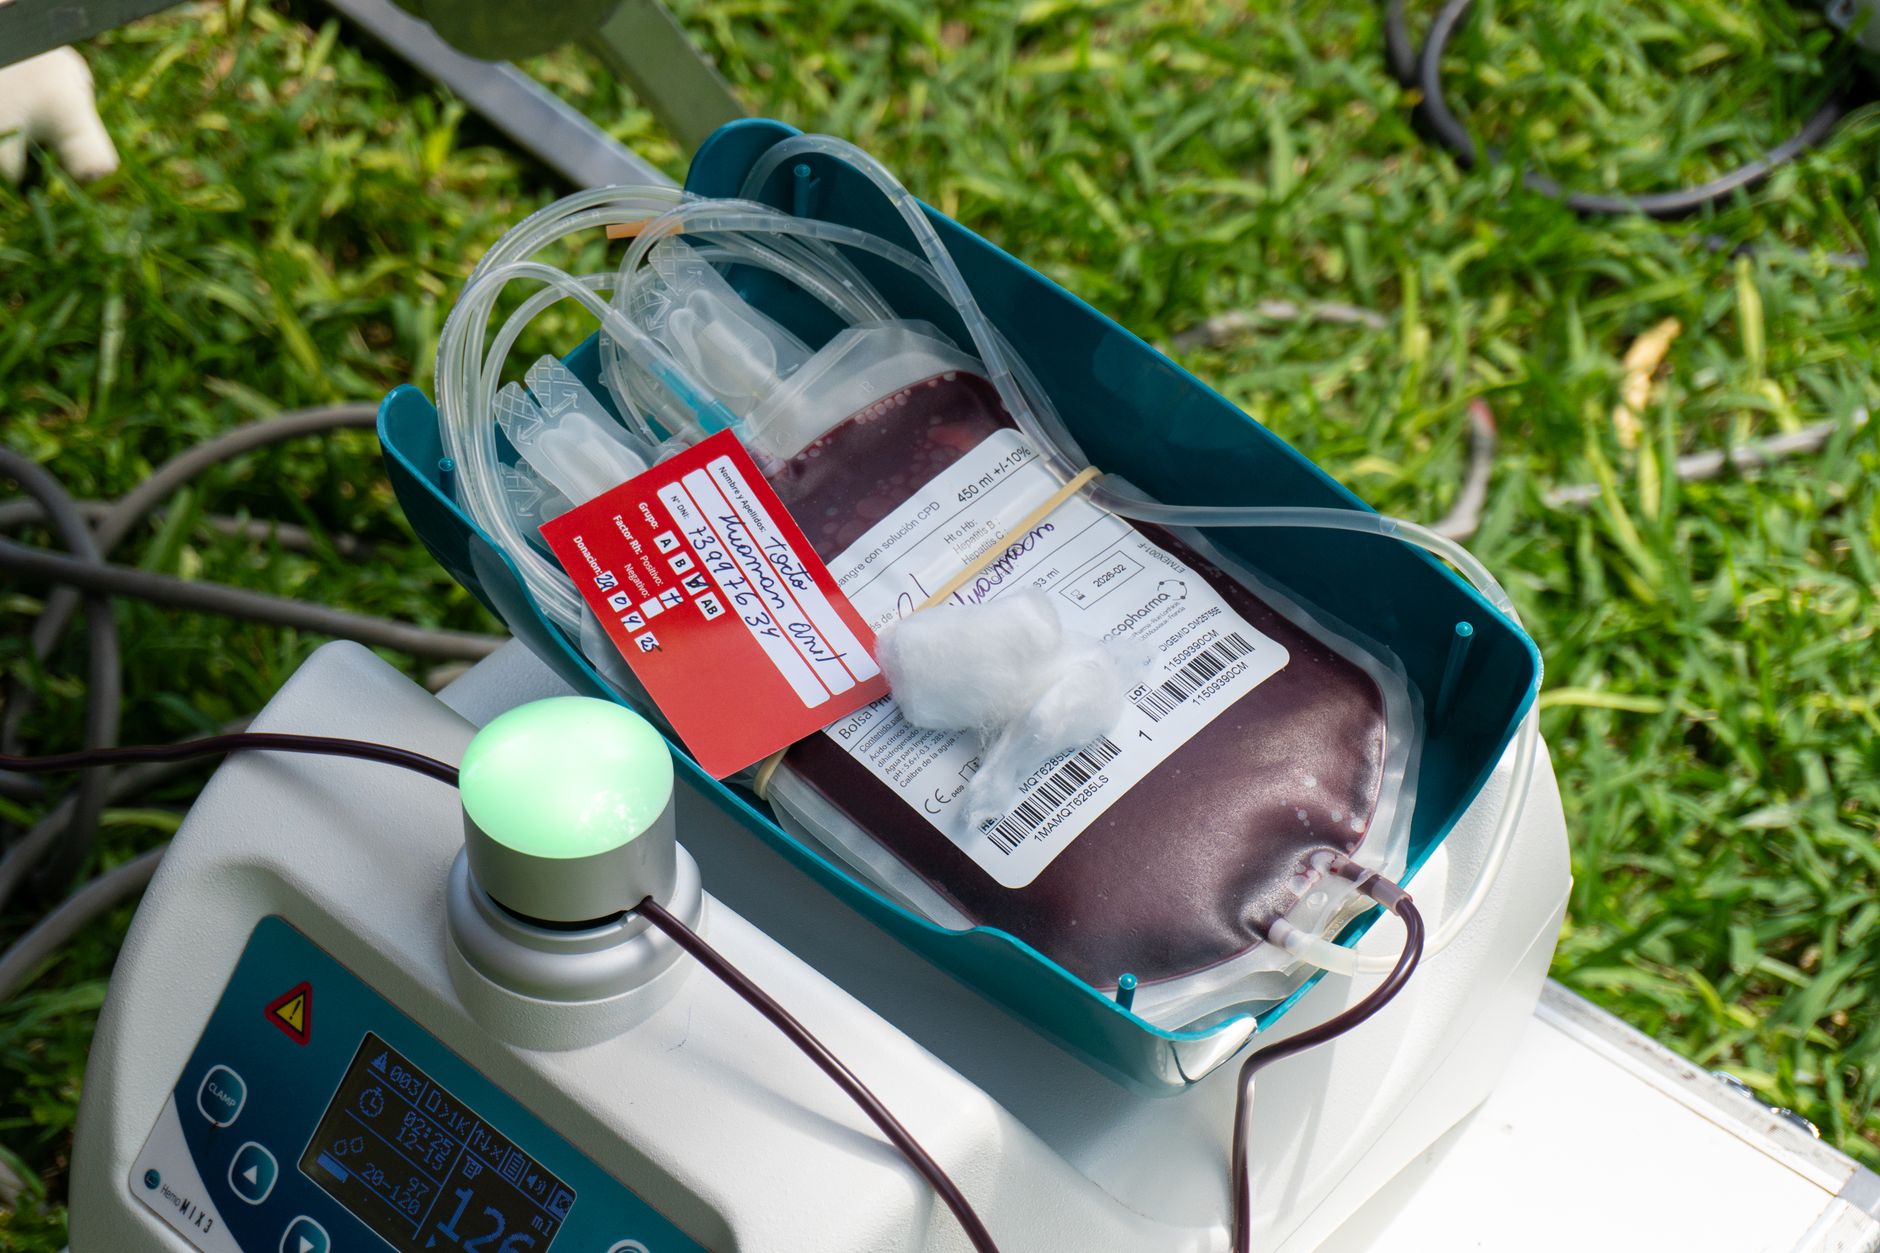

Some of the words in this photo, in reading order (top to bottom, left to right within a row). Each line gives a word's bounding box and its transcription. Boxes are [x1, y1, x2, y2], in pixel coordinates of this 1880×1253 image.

[955, 482, 980, 505] 450
[976, 472, 994, 489] ml
[990, 443, 1031, 478] +/-10%
[675, 503, 690, 521] DNI:
[718, 465, 740, 495] Nombre
[739, 498, 766, 533] Apellidos:
[835, 562, 866, 589] angre
[862, 545, 884, 564] con
[880, 516, 918, 550] solución
[915, 499, 941, 522] CPD
[943, 531, 957, 545] Ht
[960, 516, 978, 533] Hb:
[952, 525, 989, 555] Hepatitis
[572, 534, 603, 576] Donacion:
[612, 514, 633, 541] Factor
[629, 538, 643, 556] Rh:
[639, 554, 664, 587] Positivo:
[638, 501, 659, 529] Grupo:
[660, 539, 671, 548] A
[674, 558, 686, 568] B
[700, 597, 718, 616] AB
[961, 535, 996, 565] Hepatitis
[1137, 541, 1185, 574] ETMEX001-F
[623, 562, 651, 599] Negativo:
[1045, 565, 1060, 580] ml
[1091, 563, 1127, 587] 2026-02
[878, 610, 894, 625] de
[1158, 626, 1191, 652] DIGEMID
[1162, 628, 1219, 672] 11509390CM
[1128, 683, 1148, 701] LOT
[1191, 660, 1249, 706] 11509390CM
[838, 708, 873, 740] Bolsa
[858, 722, 892, 752] Contenido
[1138, 729, 1153, 741] 1
[868, 742, 888, 761] Ácido
[875, 727, 919, 767] dihidrogenado
[883, 756, 903, 775] Agua
[899, 746, 916, 761] para
[898, 765, 923, 788] Calibre
[920, 756, 932, 768] de
[929, 750, 939, 760] la
[936, 737, 957, 755] aguja
[890, 768, 905, 782] pH
[1032, 773, 1110, 843] 1MAMQT6285LS
[206, 1081, 236, 1109] CLAMP
[387, 1064, 423, 1096] 003
[394, 1125, 446, 1172] 12-15
[402, 1109, 455, 1157] 02:25
[360, 1161, 422, 1216] 20-120
[402, 1174, 431, 1201] 97
